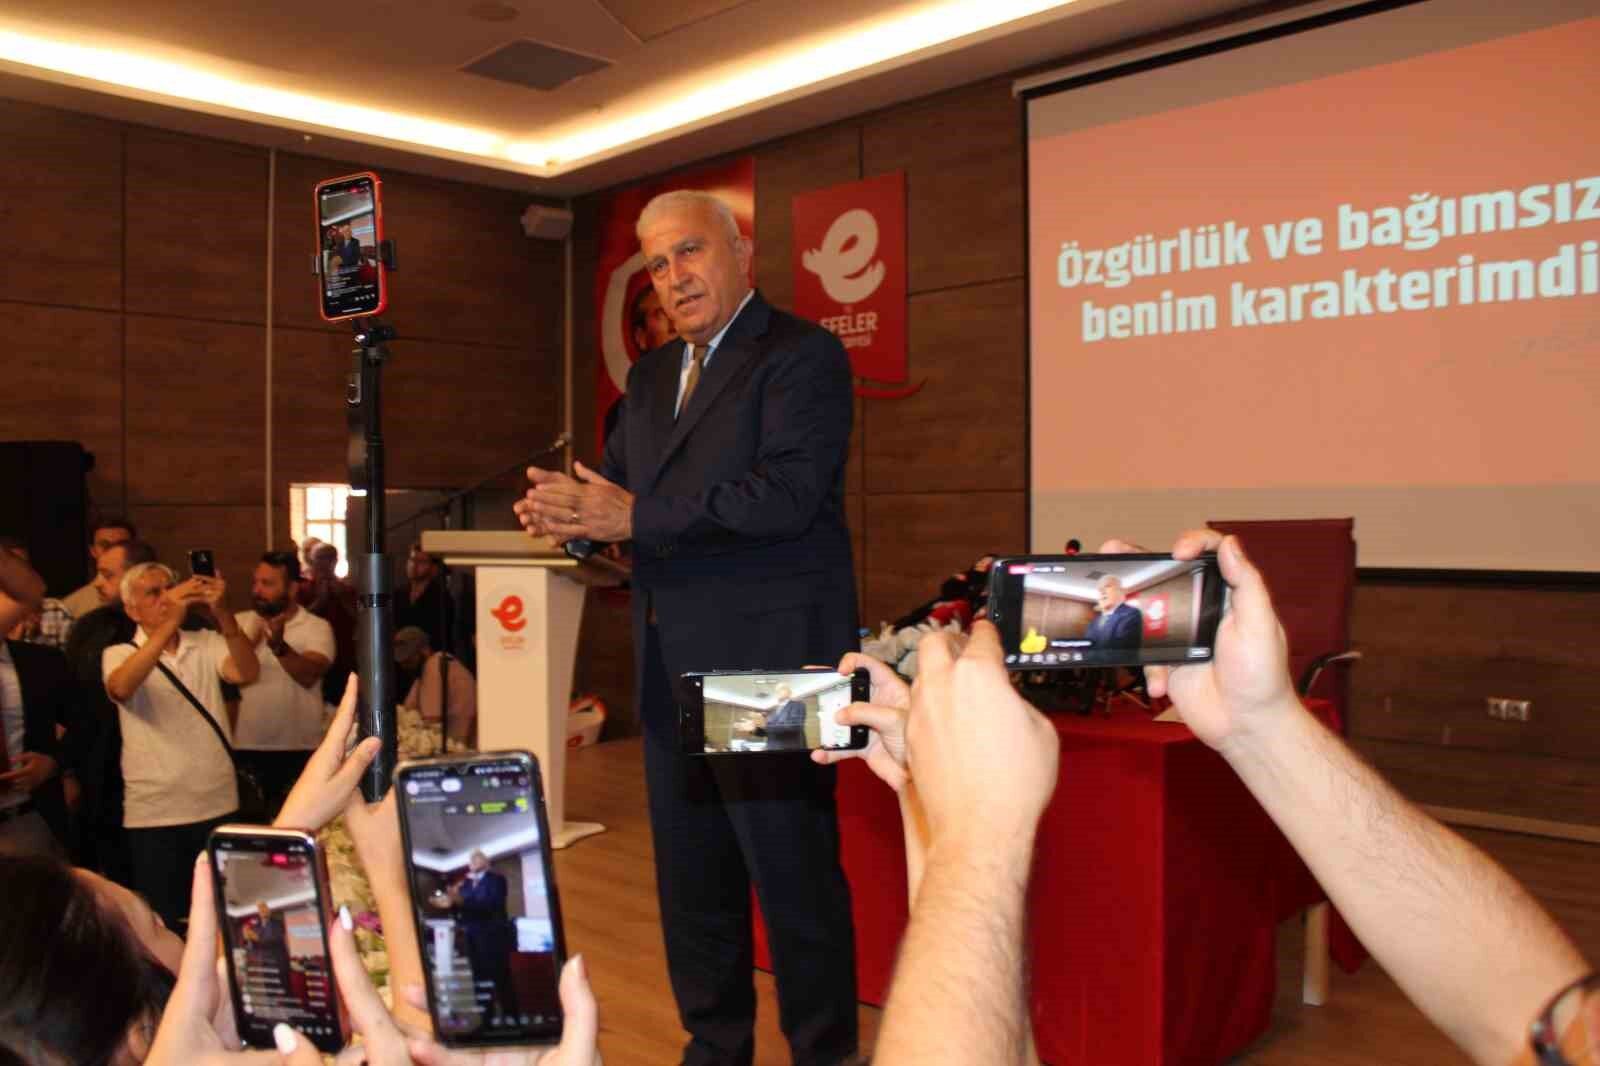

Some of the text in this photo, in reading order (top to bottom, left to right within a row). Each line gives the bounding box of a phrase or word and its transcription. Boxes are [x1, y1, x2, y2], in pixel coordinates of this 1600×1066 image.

[1057, 220, 1250, 288] Özgürlük
[1262, 217, 1323, 260] ve
[1082, 240, 1599, 342] benim karakterimdi
